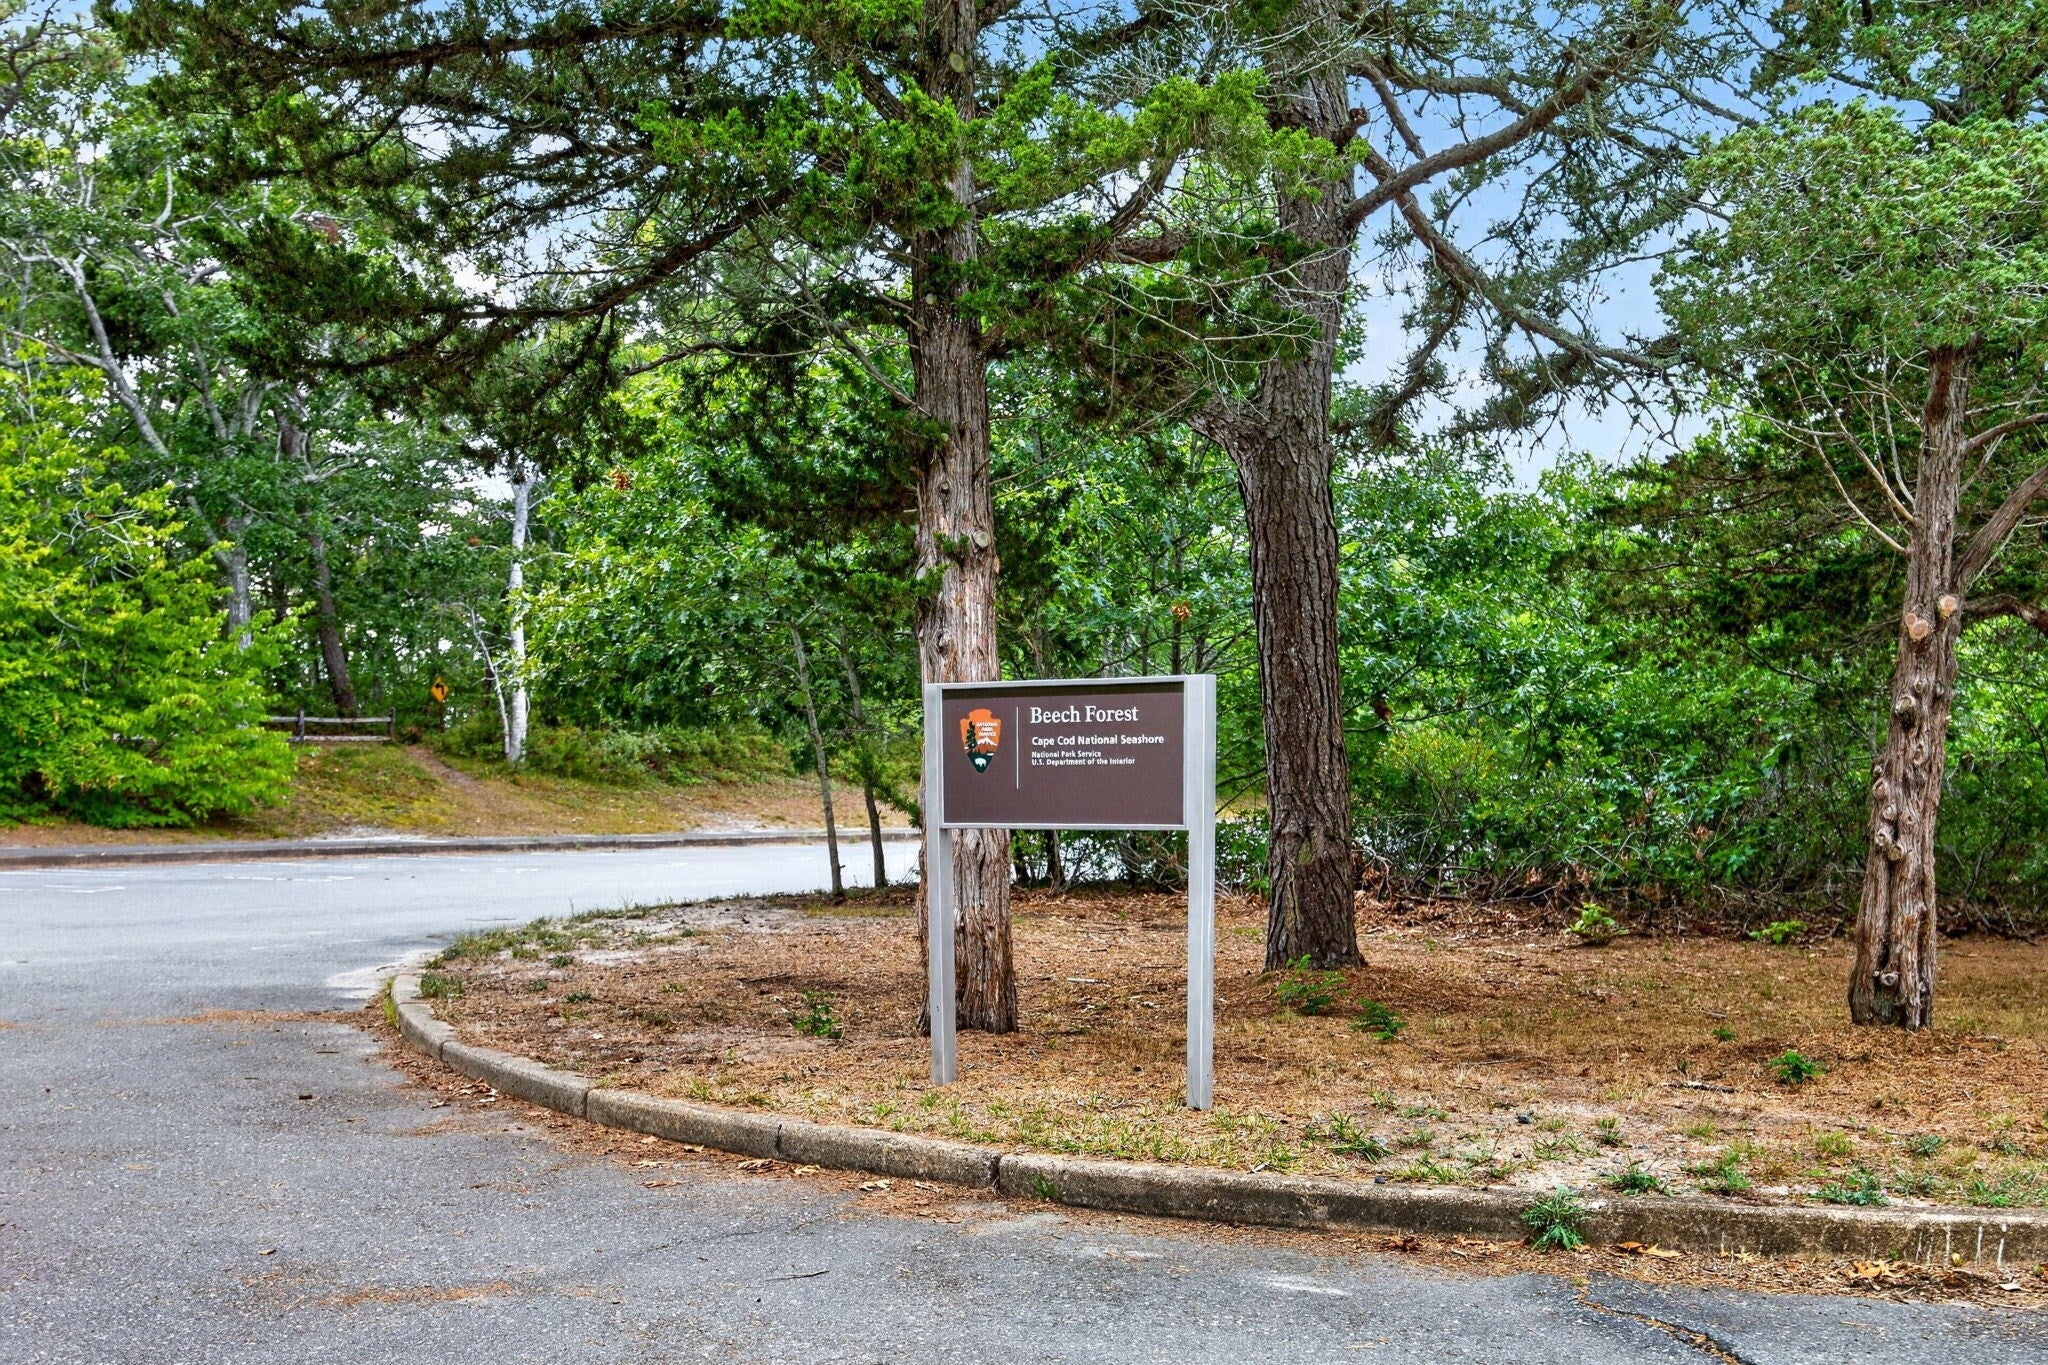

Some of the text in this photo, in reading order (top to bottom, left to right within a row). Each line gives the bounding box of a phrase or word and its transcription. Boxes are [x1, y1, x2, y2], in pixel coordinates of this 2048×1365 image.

[1030, 705, 1139, 724] Beech Forest
[1032, 734, 1164, 748] Cape Cod National Seashore
[1046, 758, 1085, 766] Department
